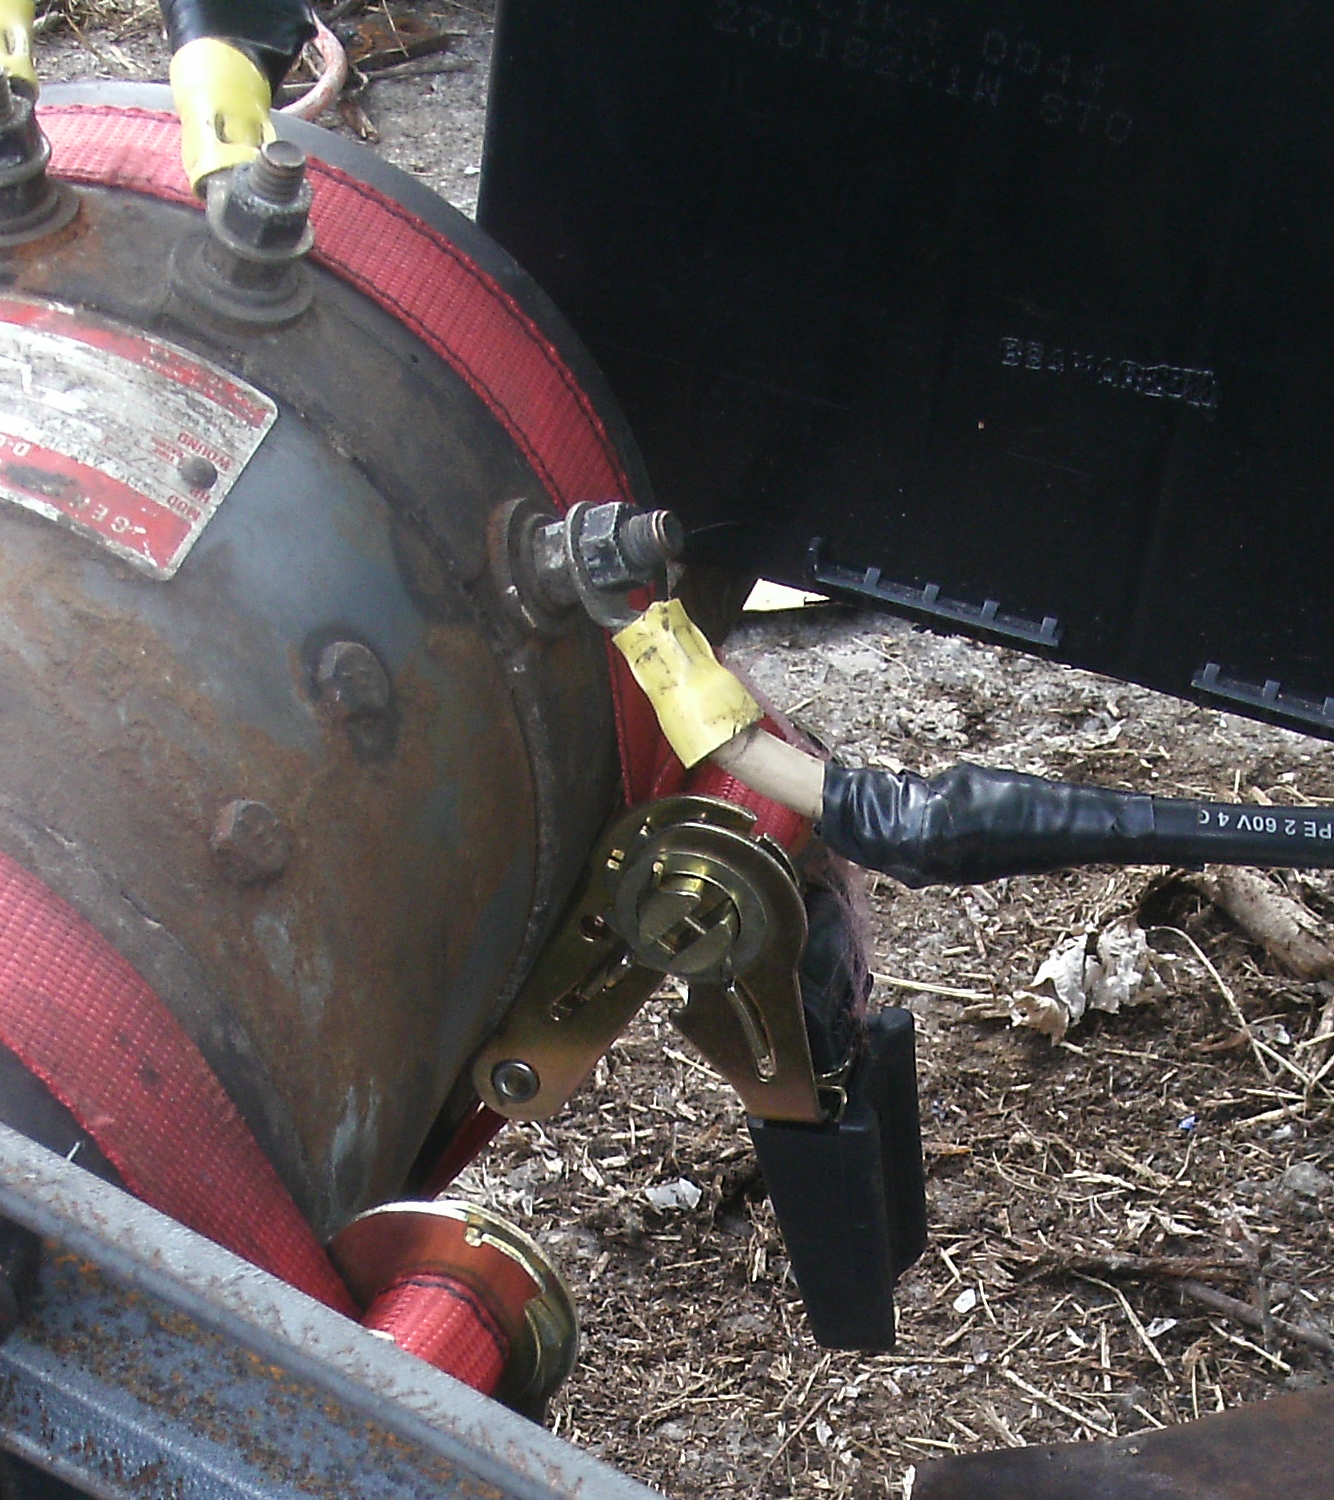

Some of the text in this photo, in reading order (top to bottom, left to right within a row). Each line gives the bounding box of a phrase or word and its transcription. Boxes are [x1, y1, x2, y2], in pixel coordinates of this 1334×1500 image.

[1216, 810, 1230, 827] 4
[1236, 811, 1278, 833] 60V
[1284, 818, 1296, 836] 2
